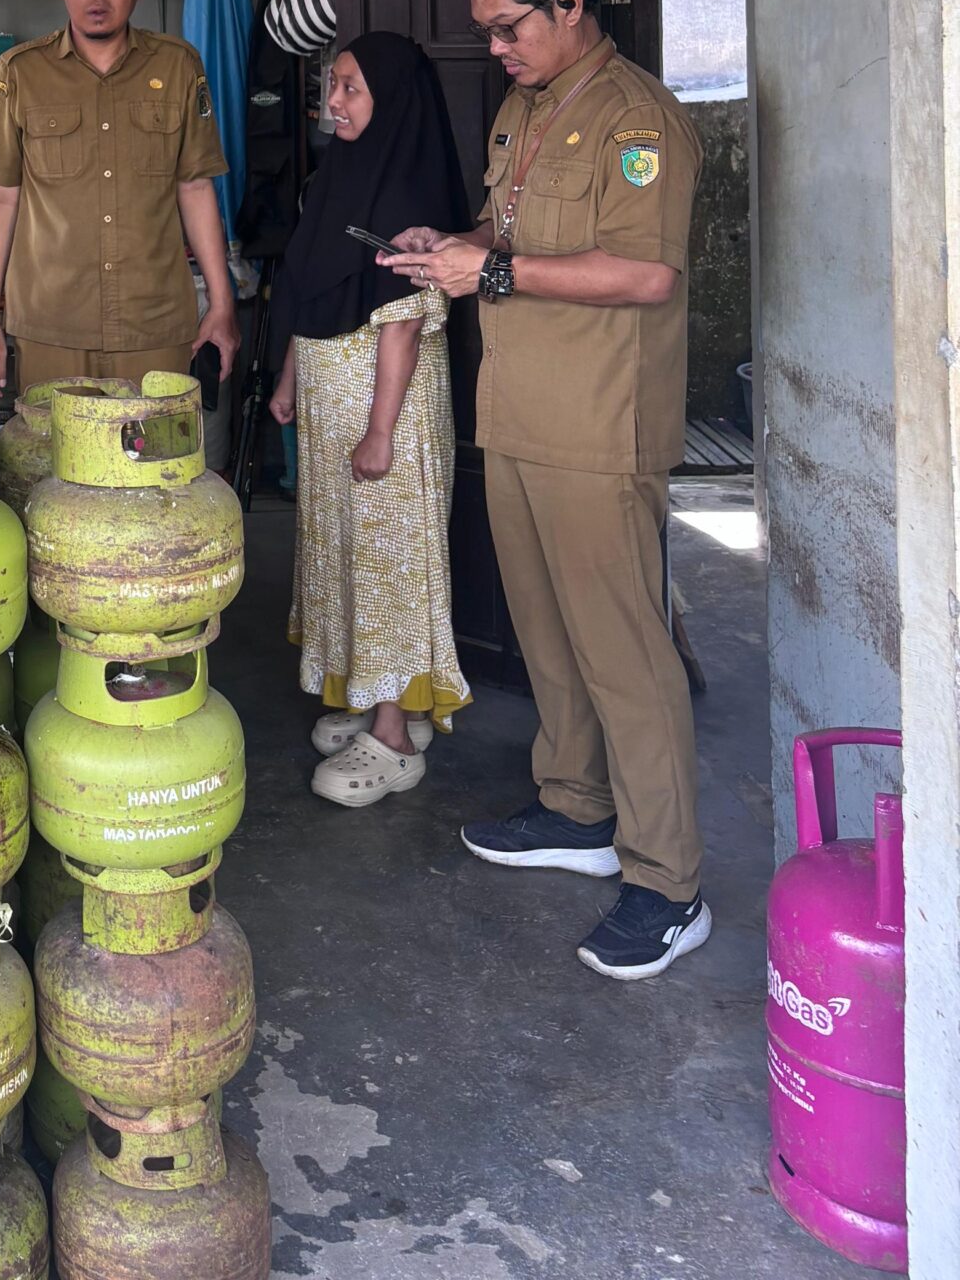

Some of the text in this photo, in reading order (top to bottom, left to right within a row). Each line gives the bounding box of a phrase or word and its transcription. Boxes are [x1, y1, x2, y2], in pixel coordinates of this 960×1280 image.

[126, 773, 224, 808] HANYA UNTUK
[782, 980, 834, 1036] Gas
